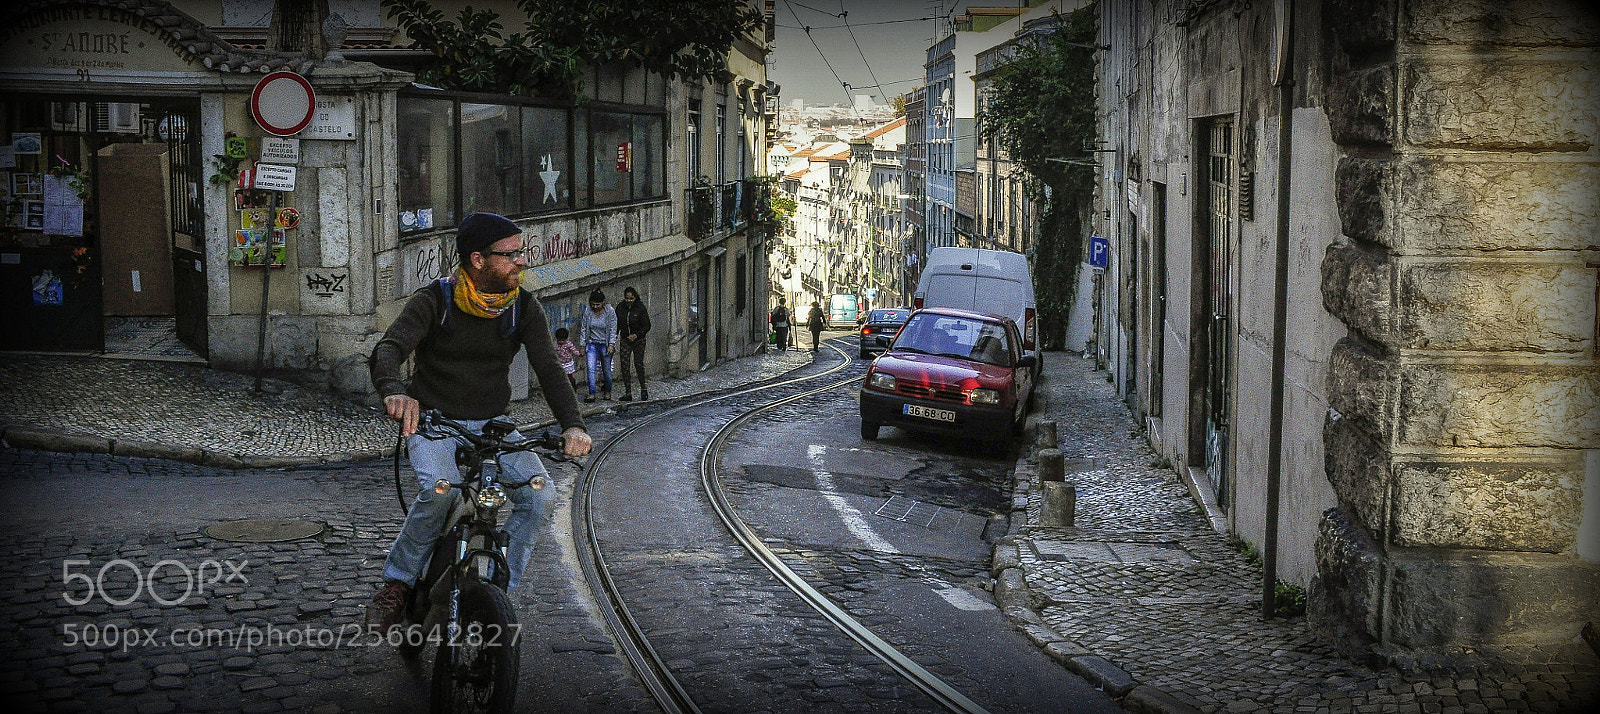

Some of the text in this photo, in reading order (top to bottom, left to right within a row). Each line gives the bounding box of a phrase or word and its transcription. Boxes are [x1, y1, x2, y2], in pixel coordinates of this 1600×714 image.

[61, 30, 130, 54] ANDRÉ
[316, 100, 336, 109] OSTA
[320, 113, 329, 121] DO
[308, 125, 342, 133] CASTELO
[1094, 241, 1104, 262] P
